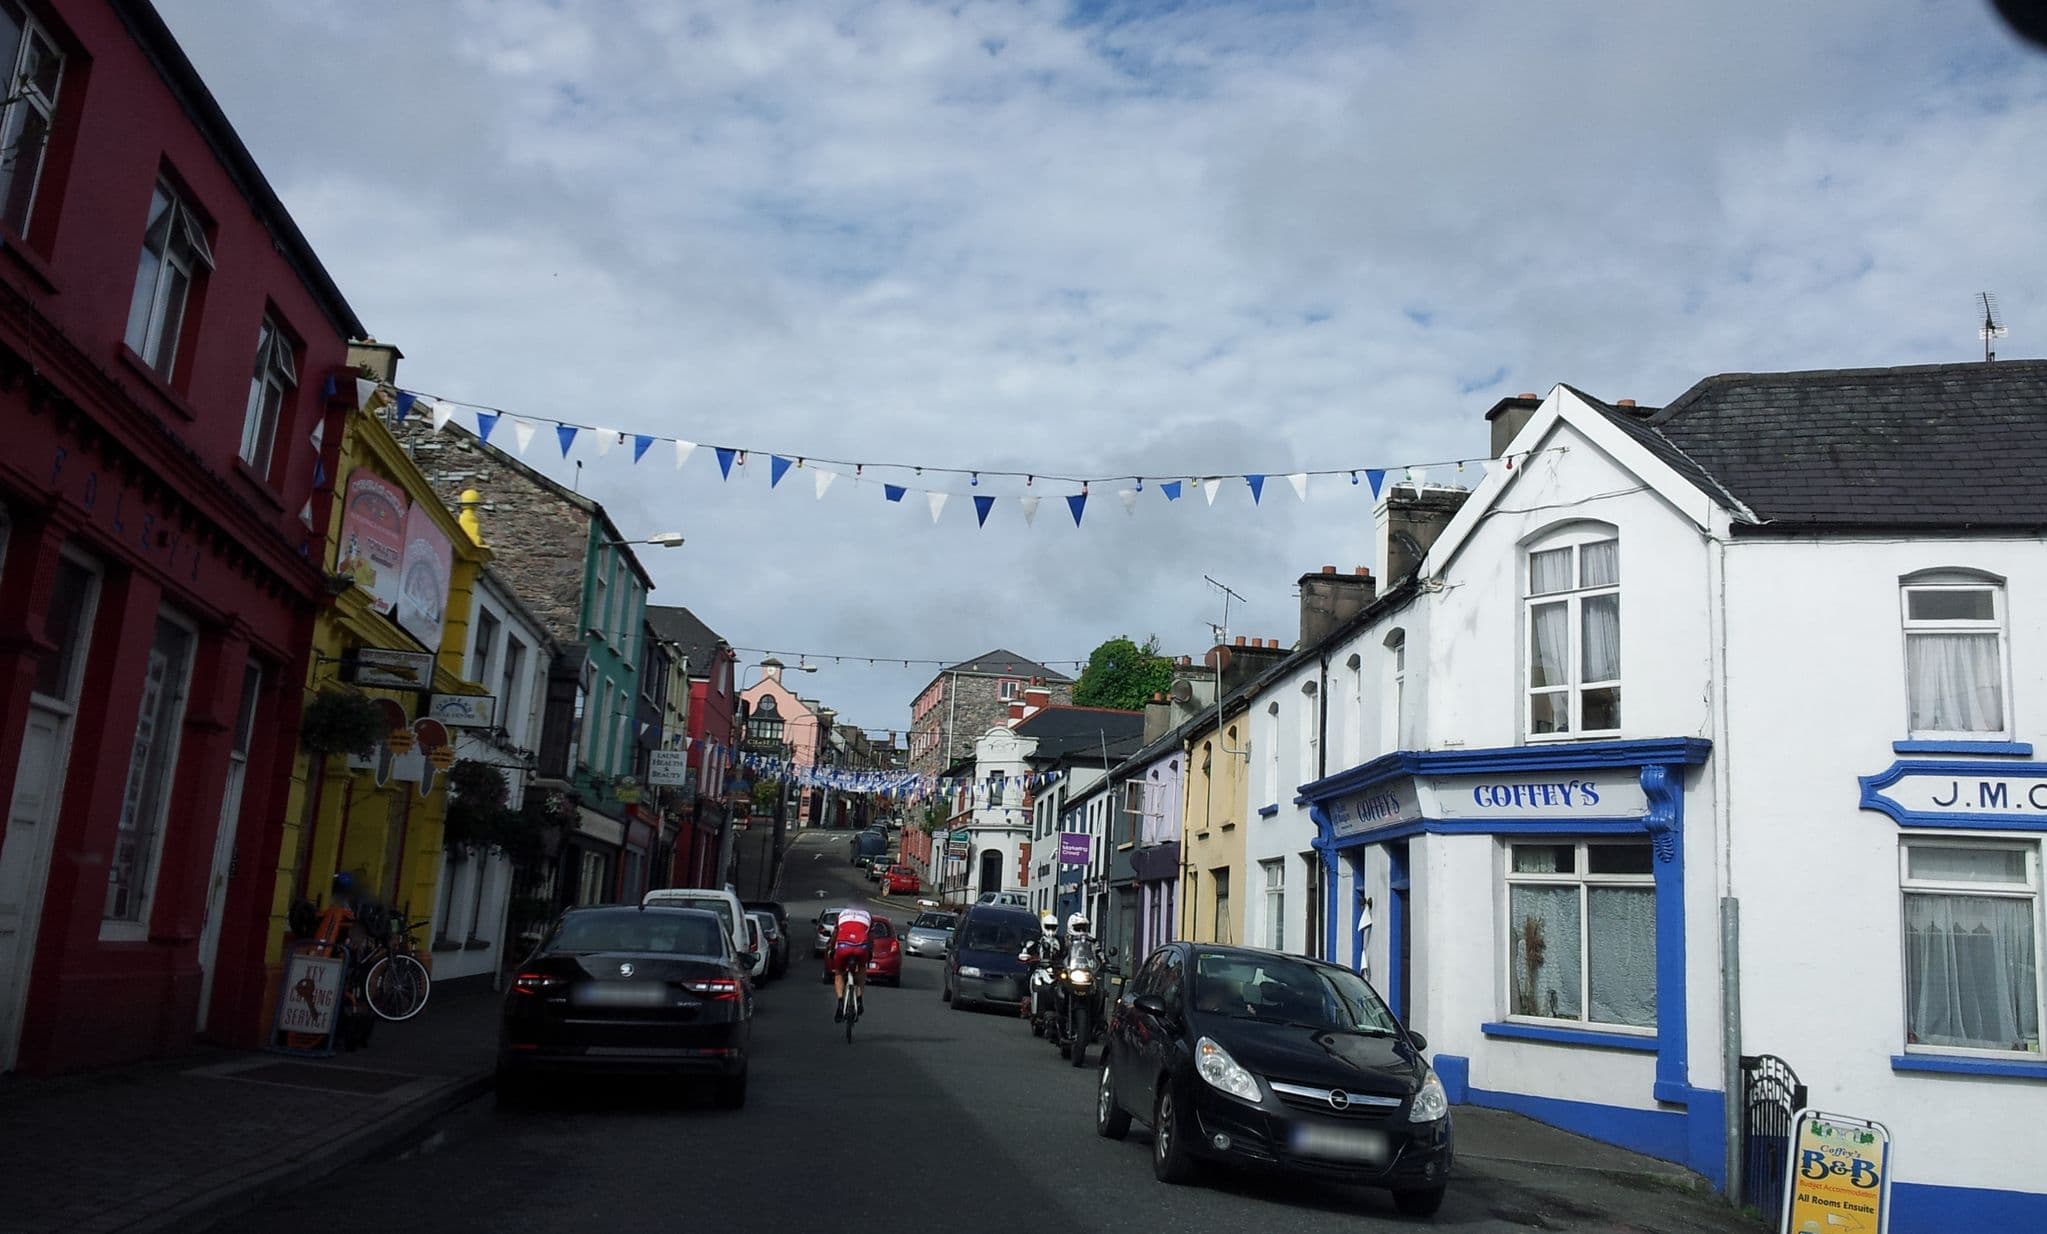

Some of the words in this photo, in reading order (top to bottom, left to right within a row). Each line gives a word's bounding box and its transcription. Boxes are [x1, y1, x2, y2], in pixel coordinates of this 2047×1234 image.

[1356, 791, 1400, 823] COFFEY'S
[1473, 779, 1600, 808] COFFEY'S
[1801, 1149, 1879, 1189] B&B
[1798, 1193, 1810, 1202] All
[1811, 1195, 1841, 1208] Rooms
[1843, 1201, 1875, 1214] Ensuite
